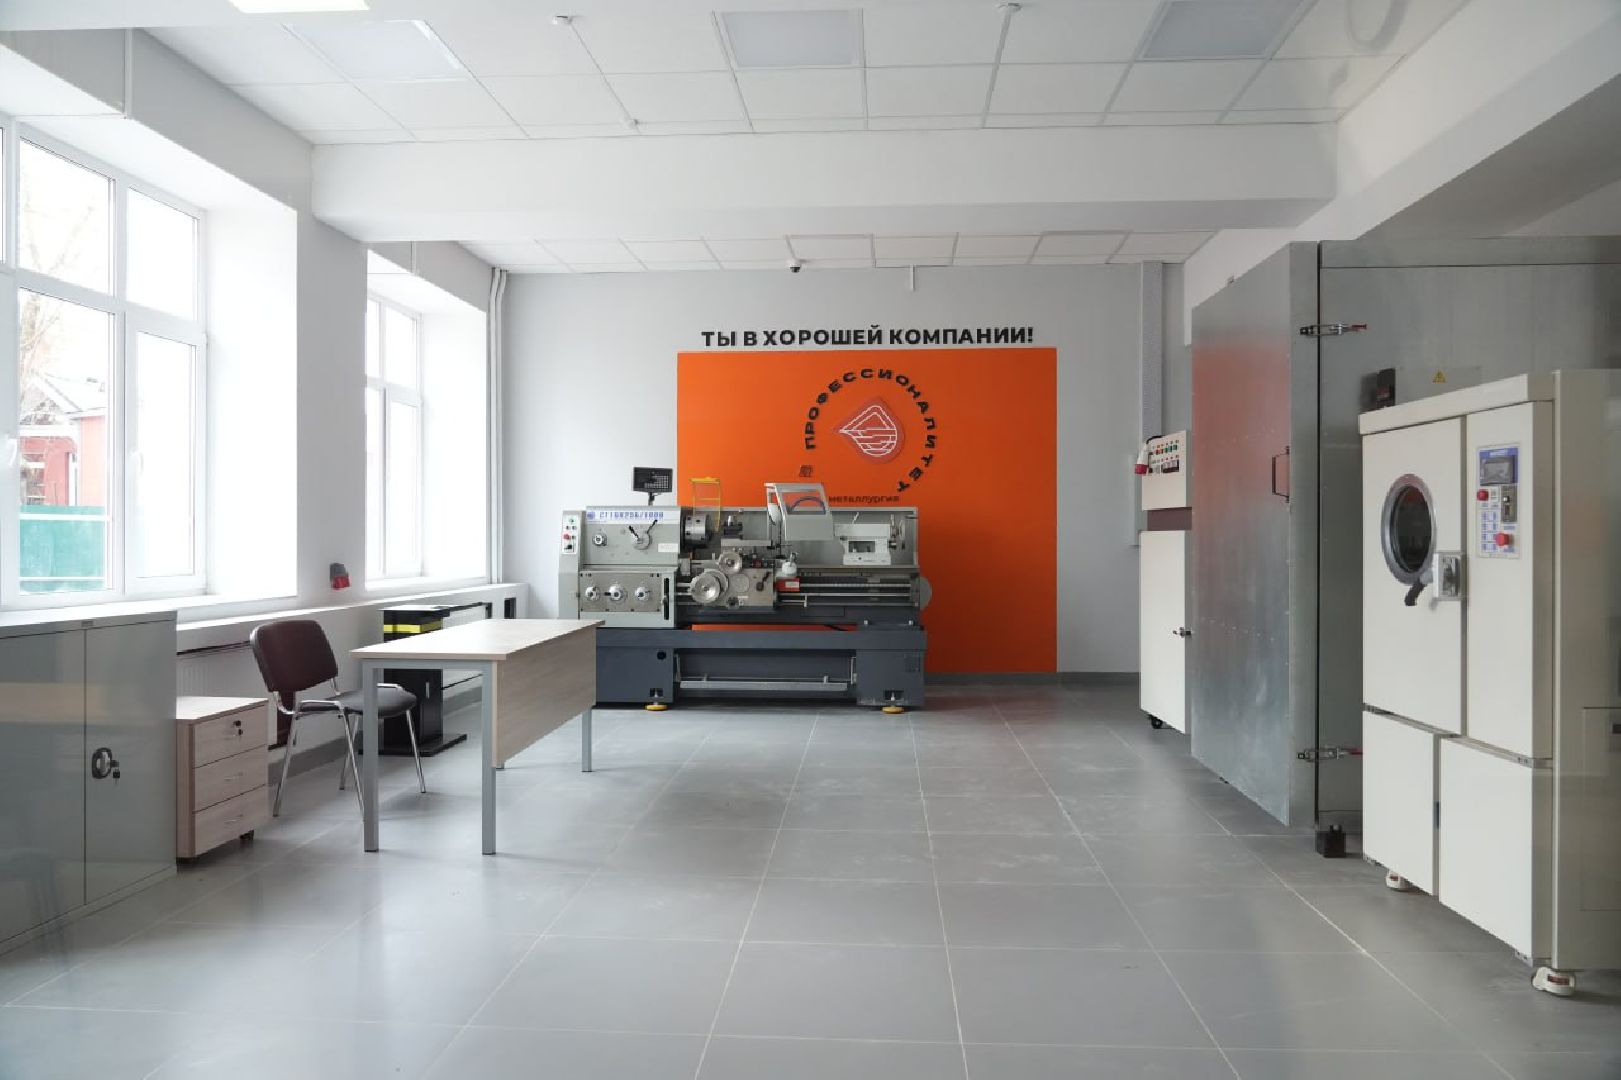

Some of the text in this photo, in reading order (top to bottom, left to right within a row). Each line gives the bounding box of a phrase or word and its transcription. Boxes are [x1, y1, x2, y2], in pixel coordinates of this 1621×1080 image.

[701, 325, 1034, 347] ТЫ В ХОРОШЕЙ КОМПАНИИ!
[804, 368, 937, 492] ПРОФЕССИОНАЛИТЕТ
[828, 495, 900, 504] металлургия
